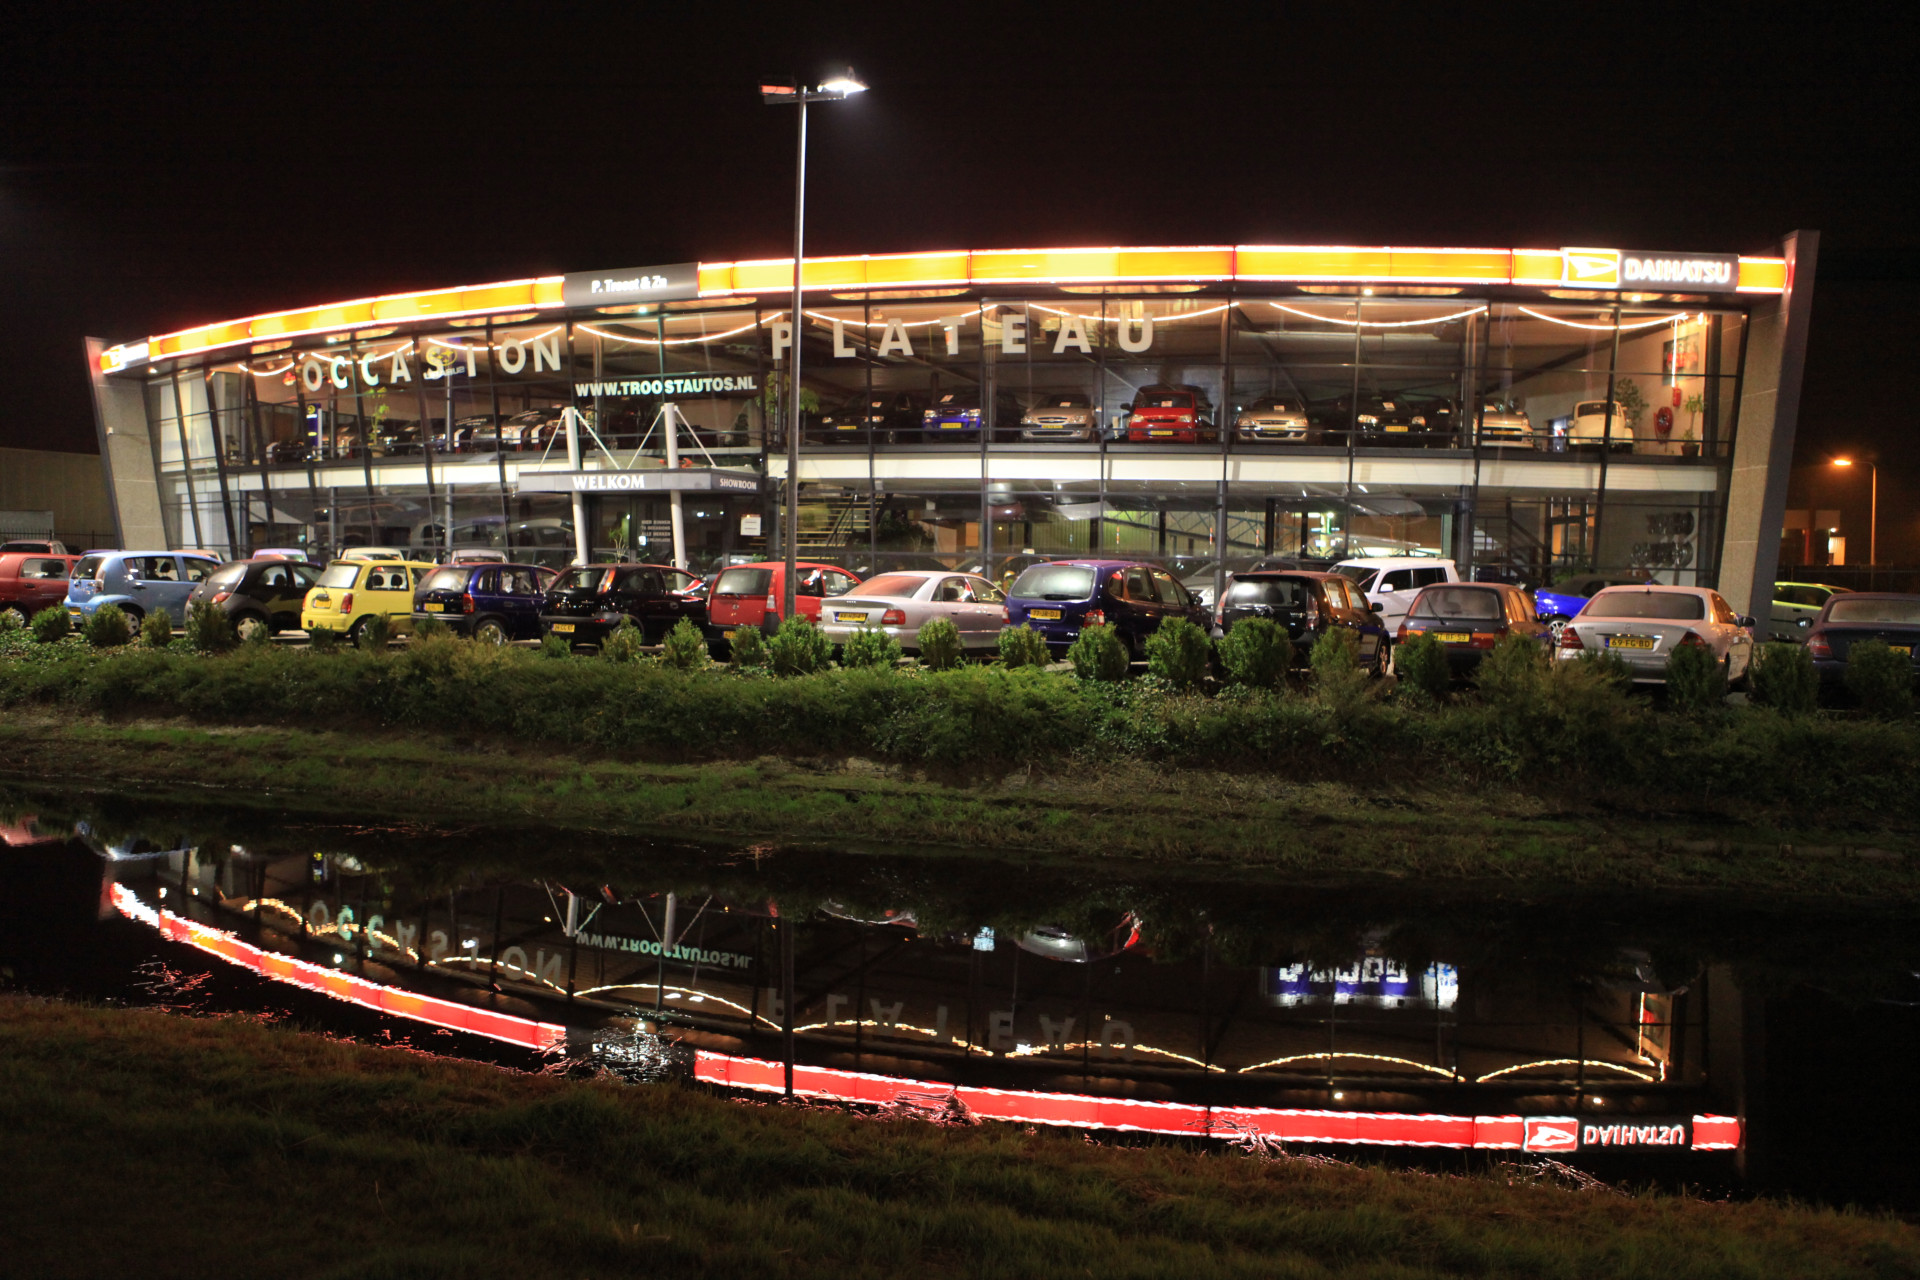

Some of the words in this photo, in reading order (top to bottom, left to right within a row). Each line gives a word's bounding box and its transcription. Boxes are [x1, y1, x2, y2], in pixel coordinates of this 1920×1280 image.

[1624, 258, 1732, 283] DAIHATSU
[772, 313, 1154, 359] PLATEAU
[303, 336, 562, 392] OCCASION
[575, 376, 757, 397] WWW.TROOSTAUTOS.NL
[572, 474, 645, 489] WELKOM
[719, 477, 758, 490] SHOWROOM
